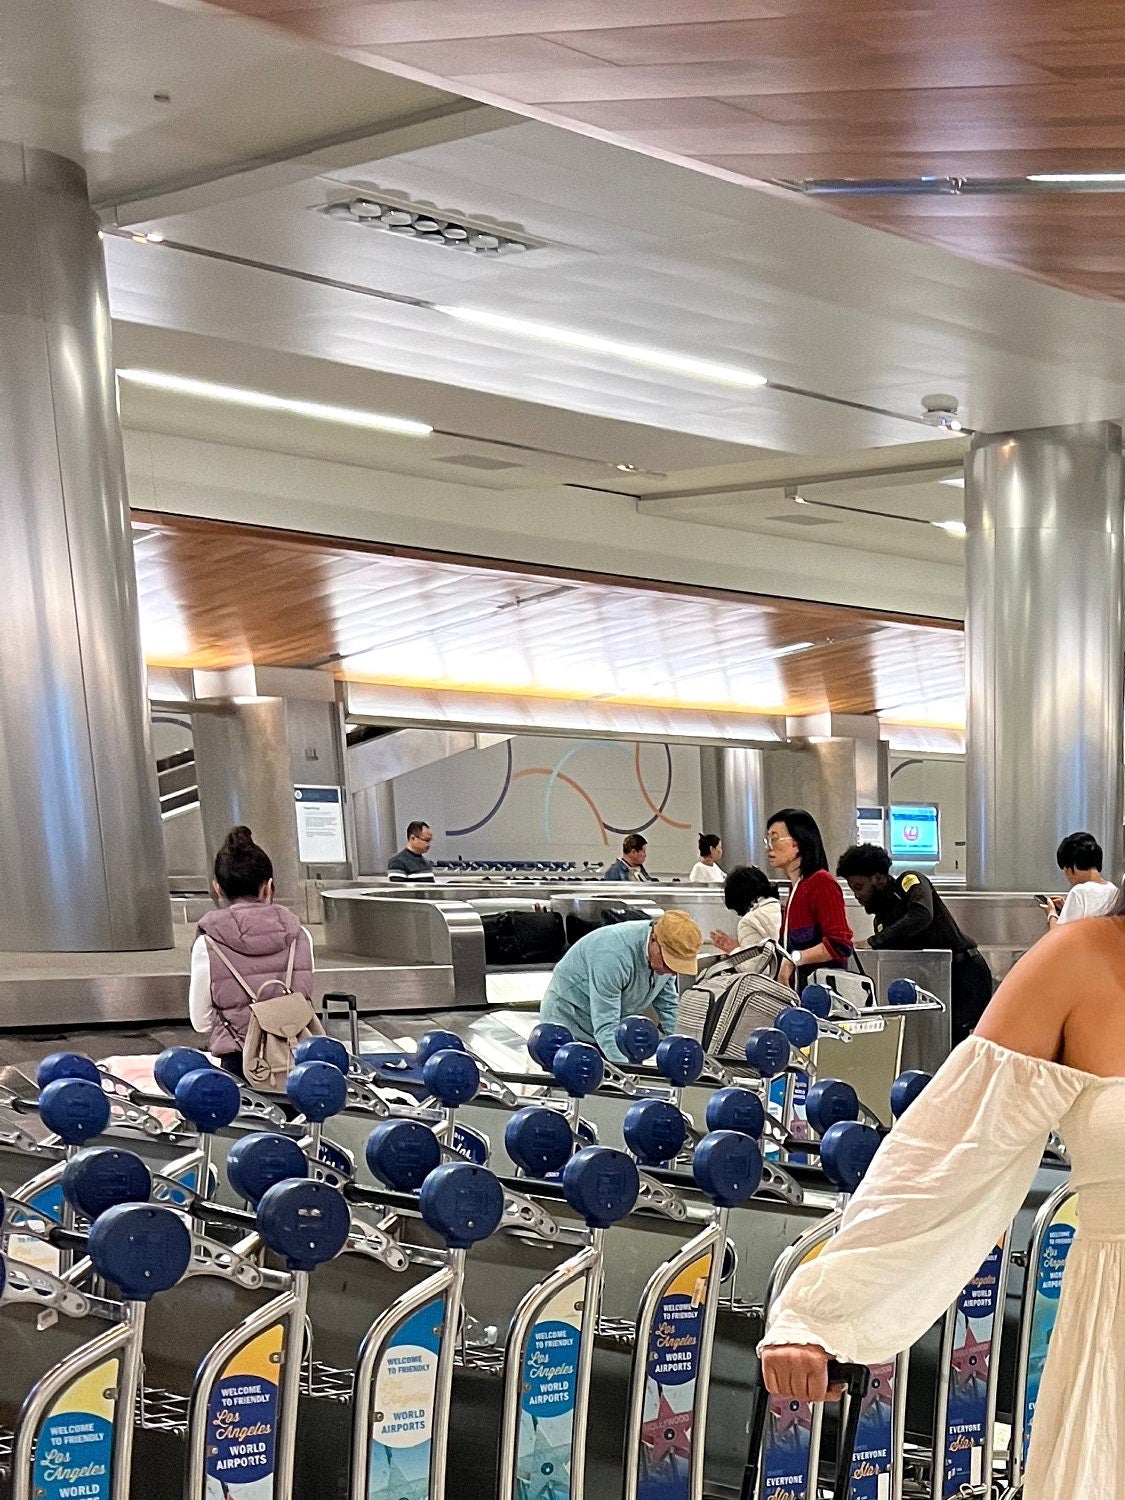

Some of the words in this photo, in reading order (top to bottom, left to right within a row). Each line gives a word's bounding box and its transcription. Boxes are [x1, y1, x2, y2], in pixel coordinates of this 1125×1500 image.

[971, 1289, 992, 1298] WORLD
[963, 1298, 992, 1308] AIRPORTS
[535, 1330, 567, 1340] WELCOME
[655, 1322, 675, 1338] Los
[535, 1341, 544, 1349] TO
[544, 1338, 574, 1348] FRIENDLY
[656, 1334, 697, 1350] Angeles
[386, 1355, 422, 1366] WELCOME
[527, 1351, 549, 1368] Los
[665, 1351, 692, 1361] WORLD
[387, 1367, 397, 1375] TO
[398, 1364, 430, 1374] FRIENDLY
[529, 1362, 574, 1380] Angeles
[655, 1362, 692, 1373] AIRPORTS
[221, 1385, 262, 1397] WELCOME
[540, 1381, 569, 1393] WORLD
[221, 1398, 232, 1406] TO
[234, 1394, 271, 1405] FRIENDLY
[529, 1392, 570, 1405] AIRPORTS
[212, 1409, 240, 1427] Los
[393, 1409, 425, 1421] WORLD
[50, 1423, 95, 1436] WELCOME
[215, 1421, 271, 1441] Angeles
[381, 1421, 426, 1434] AIRPORTS
[949, 1423, 981, 1435] EVERYONE
[51, 1437, 62, 1446] TO
[64, 1433, 104, 1445] FRIENDLY
[229, 1443, 266, 1456] WORLD
[852, 1448, 887, 1461] EVERYONE
[40, 1449, 71, 1468] Los
[216, 1455, 267, 1470] AIRPORTS
[43, 1462, 105, 1482] Angeles
[852, 1461, 881, 1480] Star
[766, 1474, 803, 1487] EVERYONE
[59, 1484, 100, 1498] WORLD
